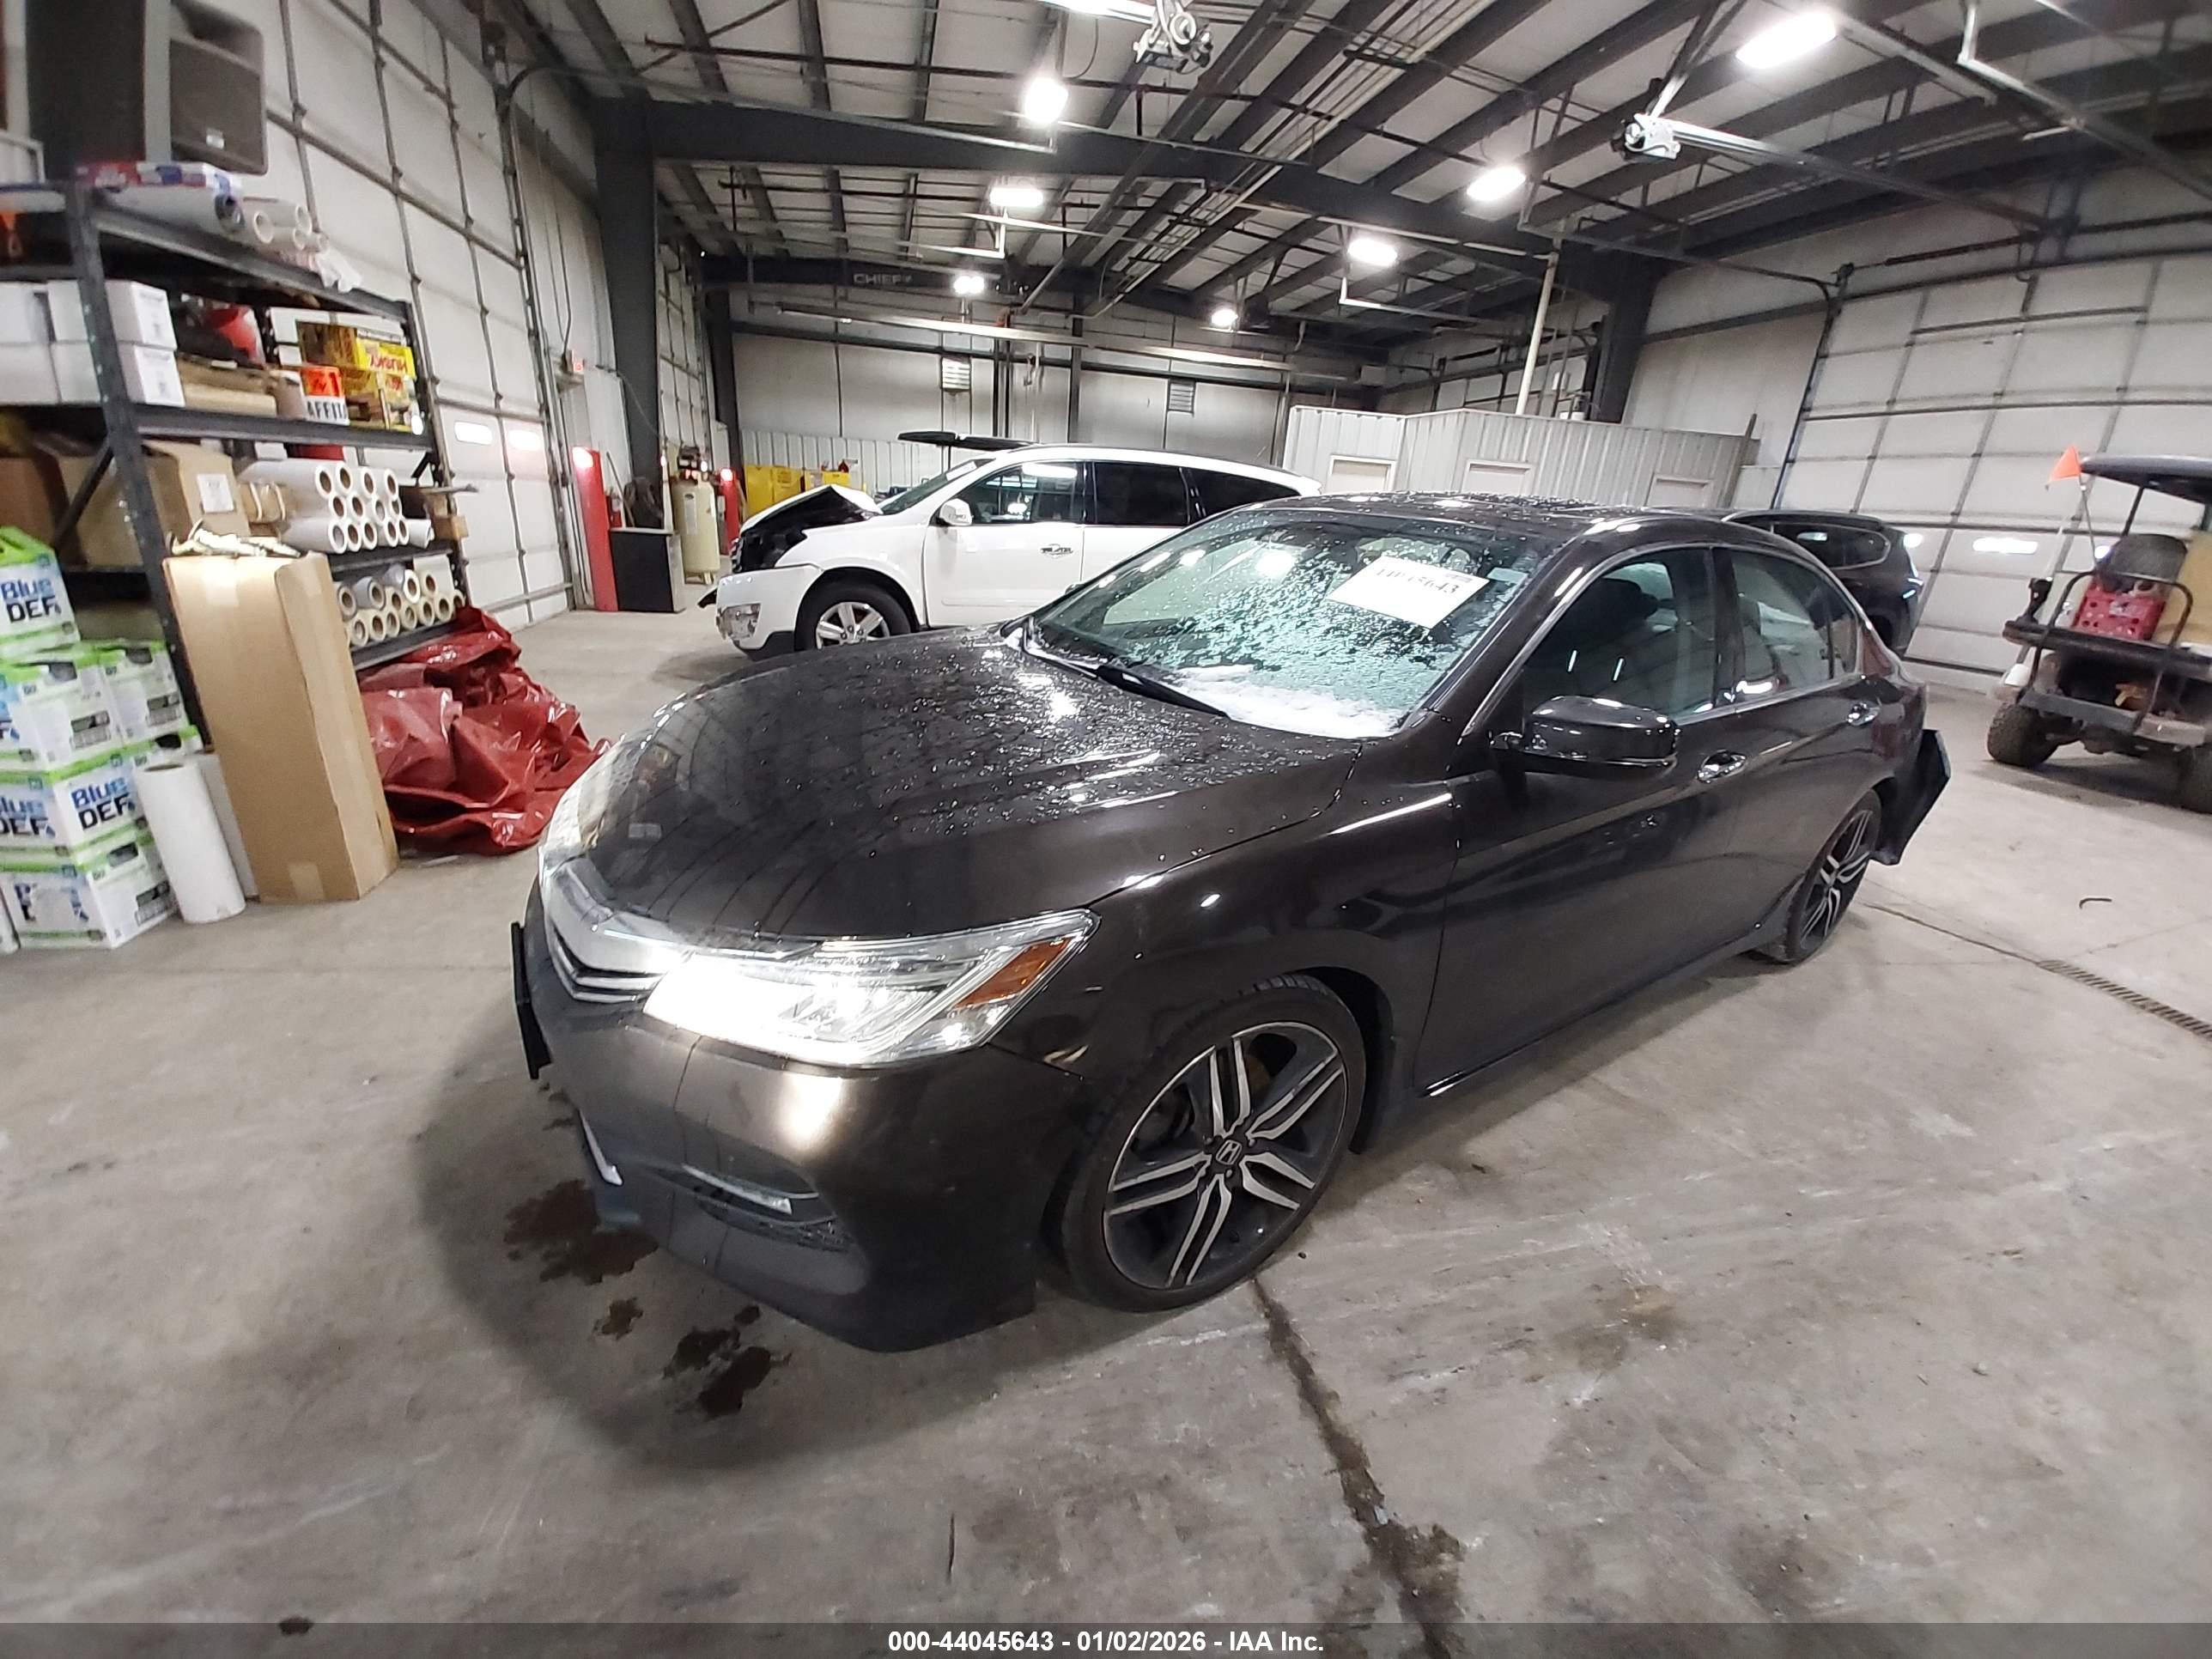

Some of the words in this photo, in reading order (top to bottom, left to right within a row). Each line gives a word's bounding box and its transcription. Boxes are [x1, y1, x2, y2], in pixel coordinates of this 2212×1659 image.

[1, 578, 54, 600] Blue
[7, 594, 57, 623] DEF
[0, 796, 46, 814] lue
[71, 776, 129, 809] Blue
[78, 792, 132, 830] DEF
